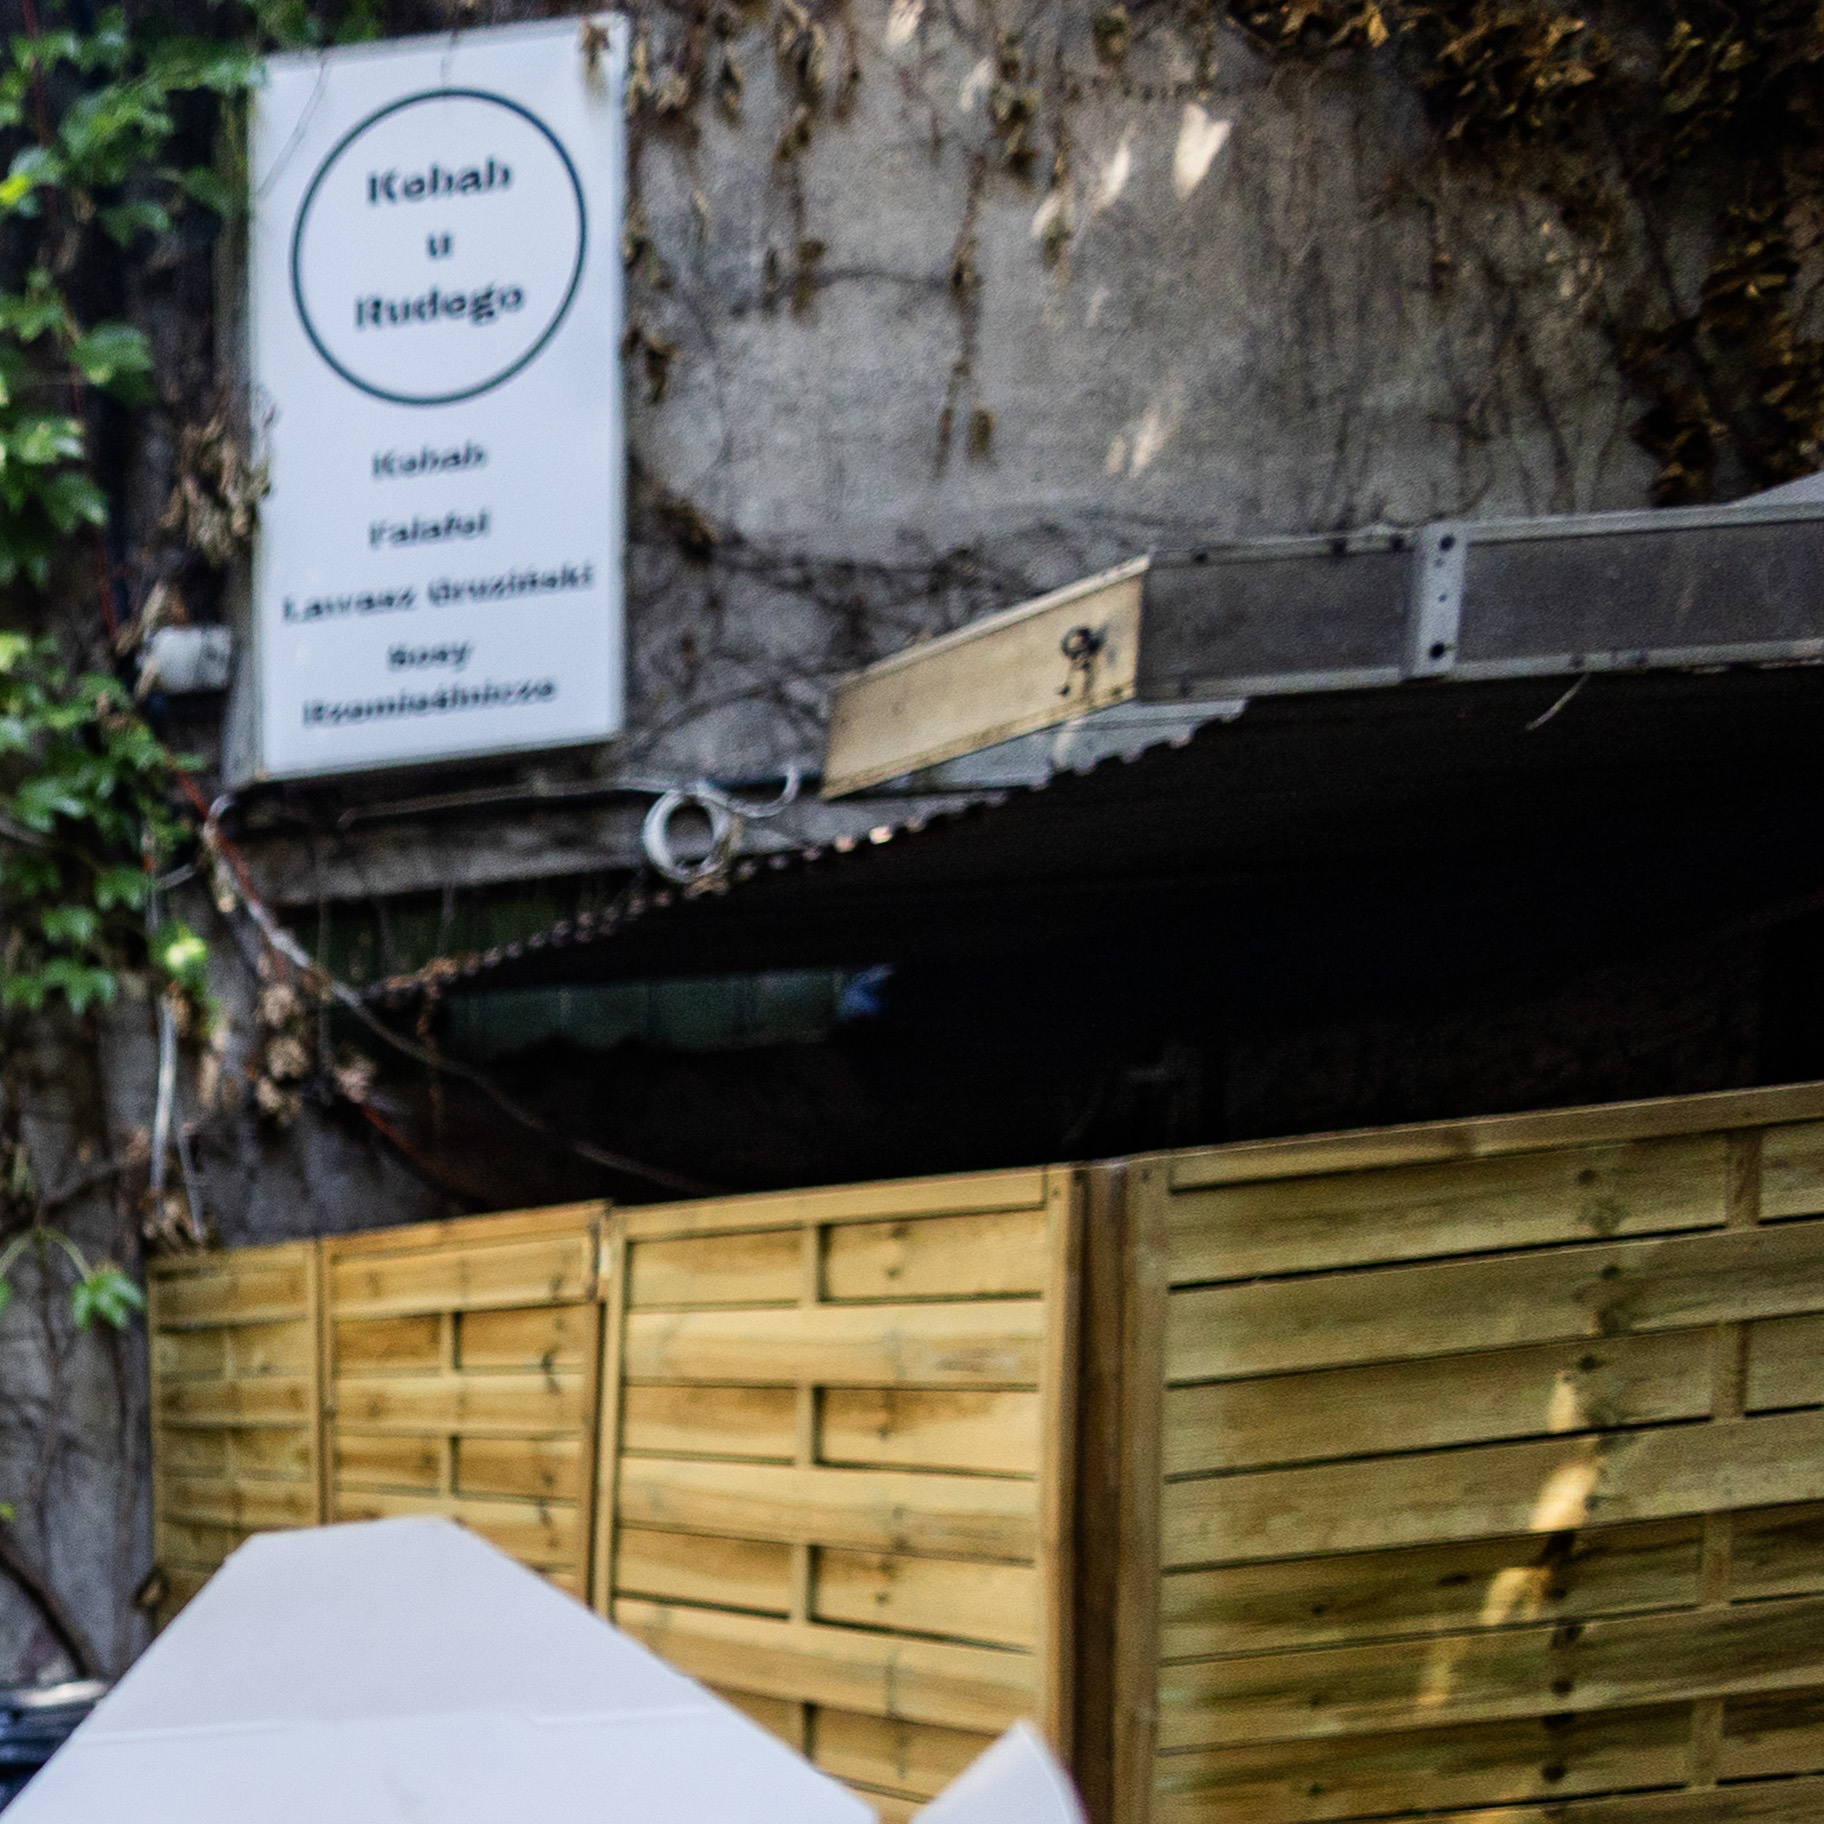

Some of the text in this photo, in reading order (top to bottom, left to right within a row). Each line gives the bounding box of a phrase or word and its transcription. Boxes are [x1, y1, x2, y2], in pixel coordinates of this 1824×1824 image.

[368, 158, 512, 205] Kebab
[427, 233, 453, 259] u
[356, 286, 523, 329] Rudego
[373, 440, 486, 478] Kebab
[370, 510, 490, 549] Falafel
